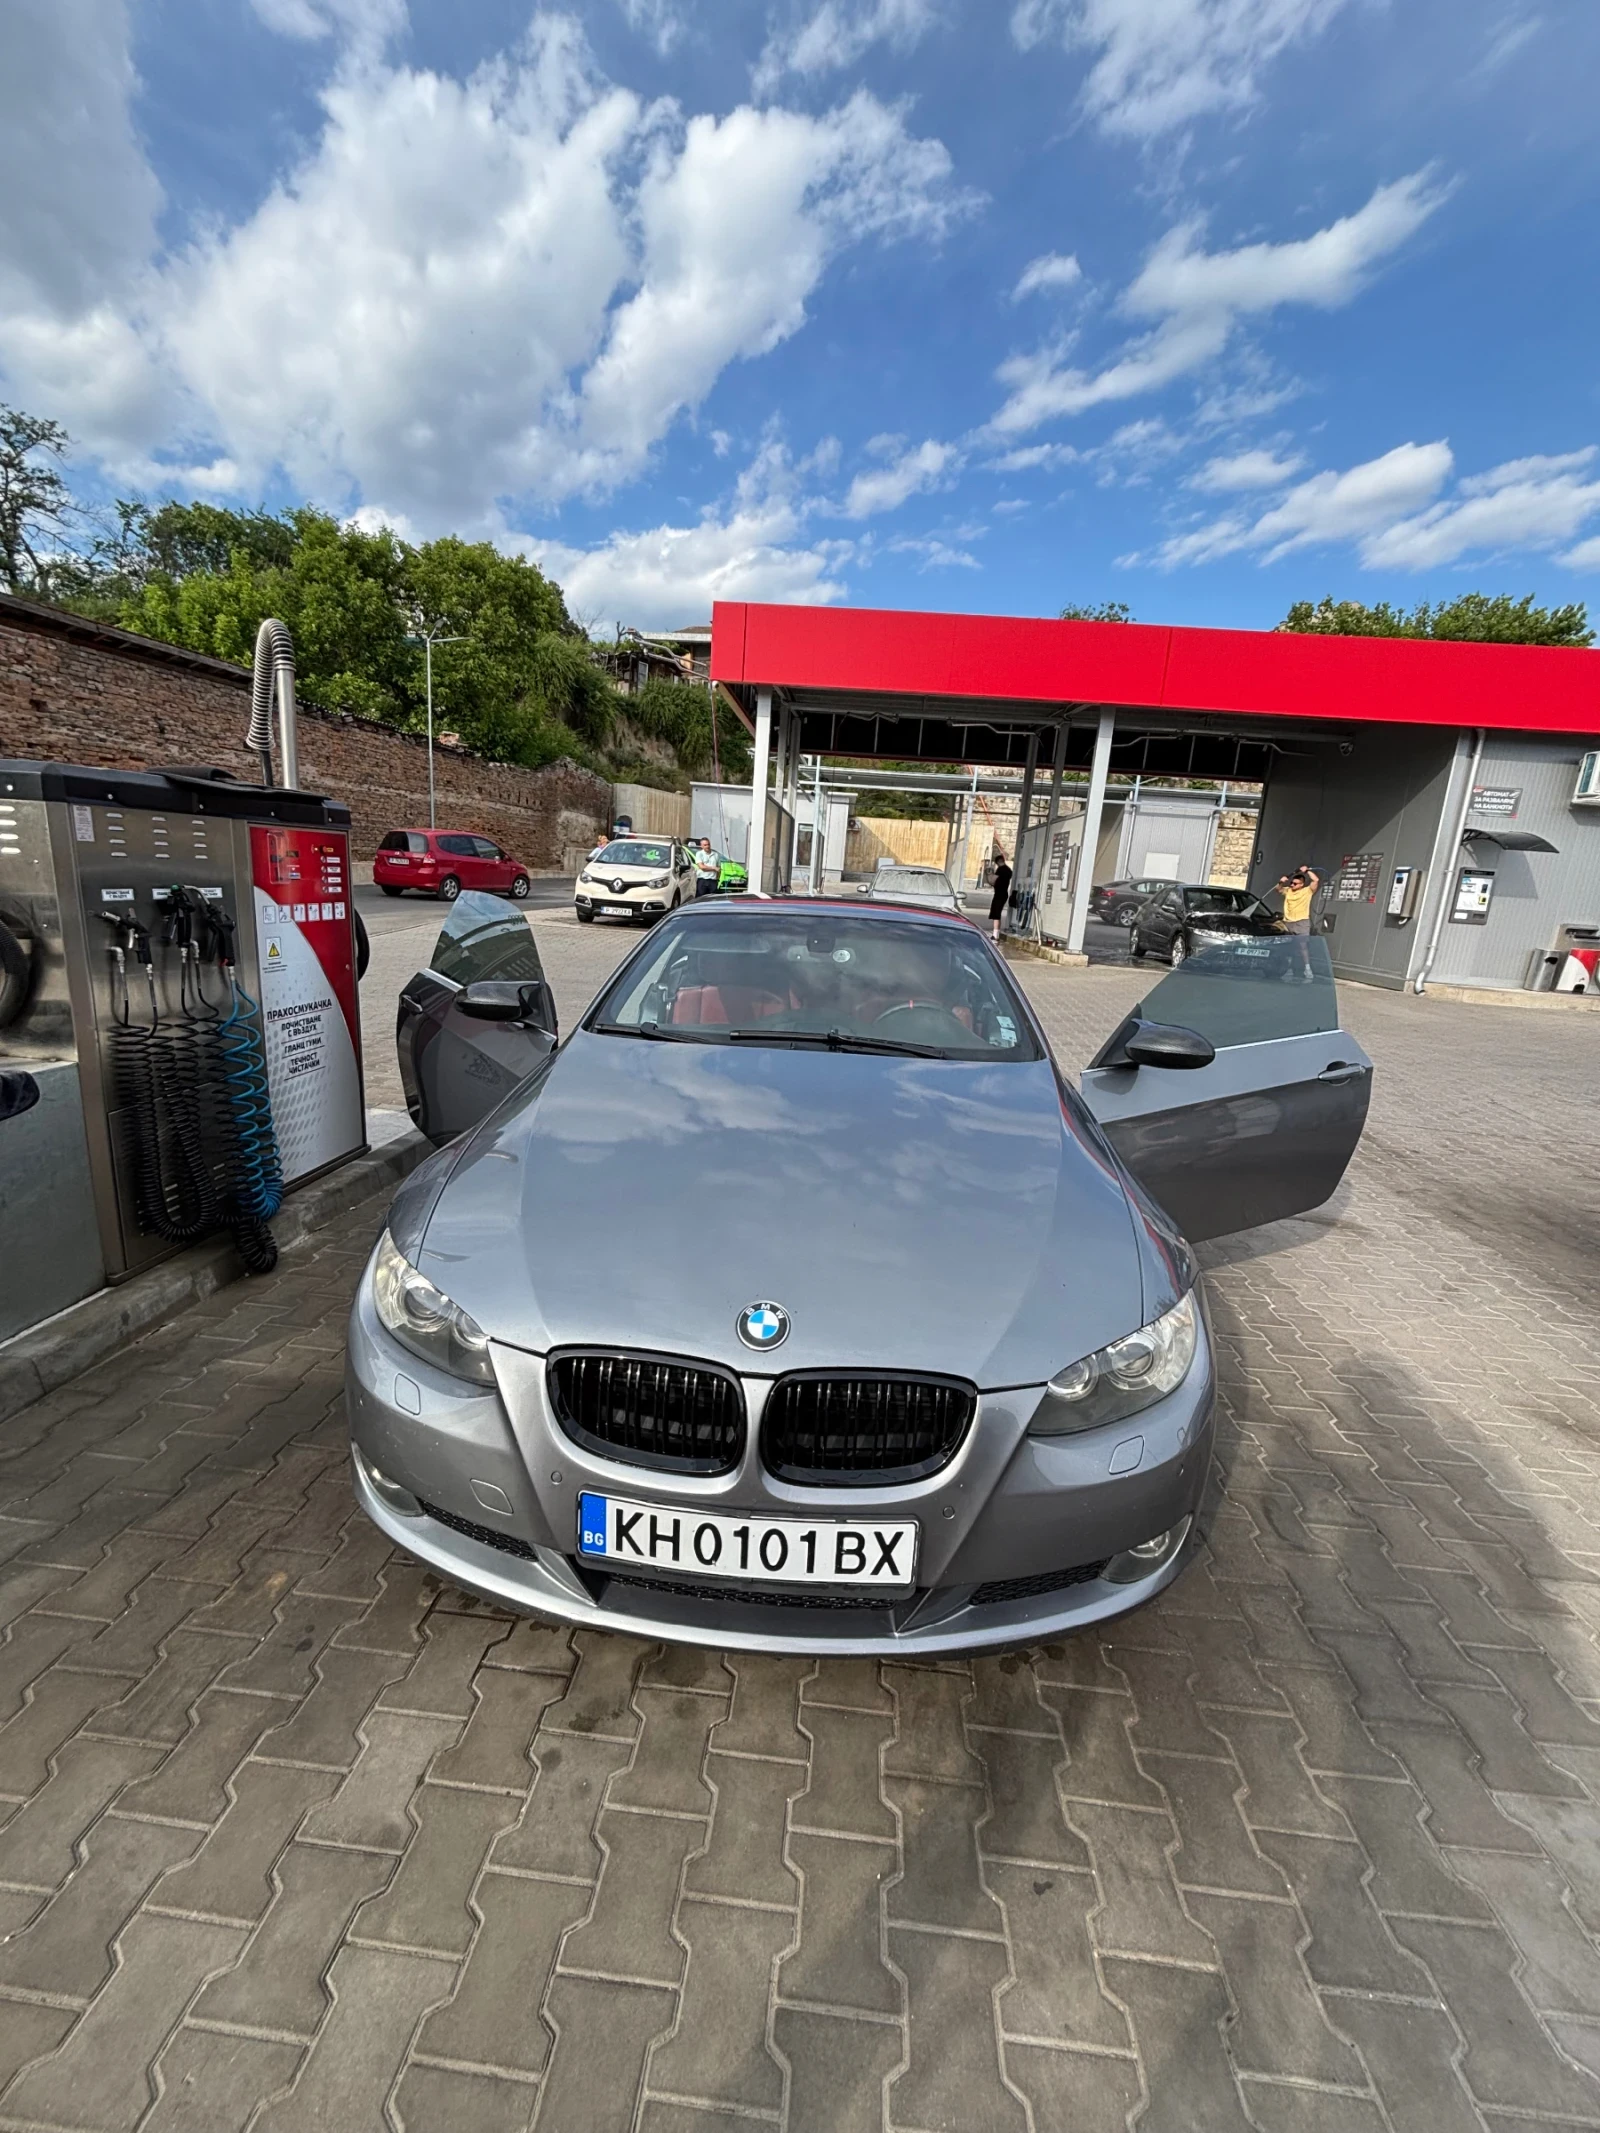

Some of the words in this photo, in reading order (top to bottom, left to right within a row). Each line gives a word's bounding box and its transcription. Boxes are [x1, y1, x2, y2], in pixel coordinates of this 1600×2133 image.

[267, 999, 332, 1020] ПРАХОСМУКАЧКА
[281, 1015, 322, 1030] ПОЧИСТВАНЕ
[293, 1024, 317, 1036] ВЪЗДУХ
[284, 1042, 305, 1053] ГЛАНЦ
[306, 1037, 322, 1047] ГУМИ
[289, 1059, 320, 1074] ЧИСТАЧКИ
[291, 1052, 317, 1066] ТЕЧНОСТ
[745, 1303, 786, 1319] BMW
[583, 1531, 605, 1546] BG
[615, 1508, 905, 1576] KH0101BX
